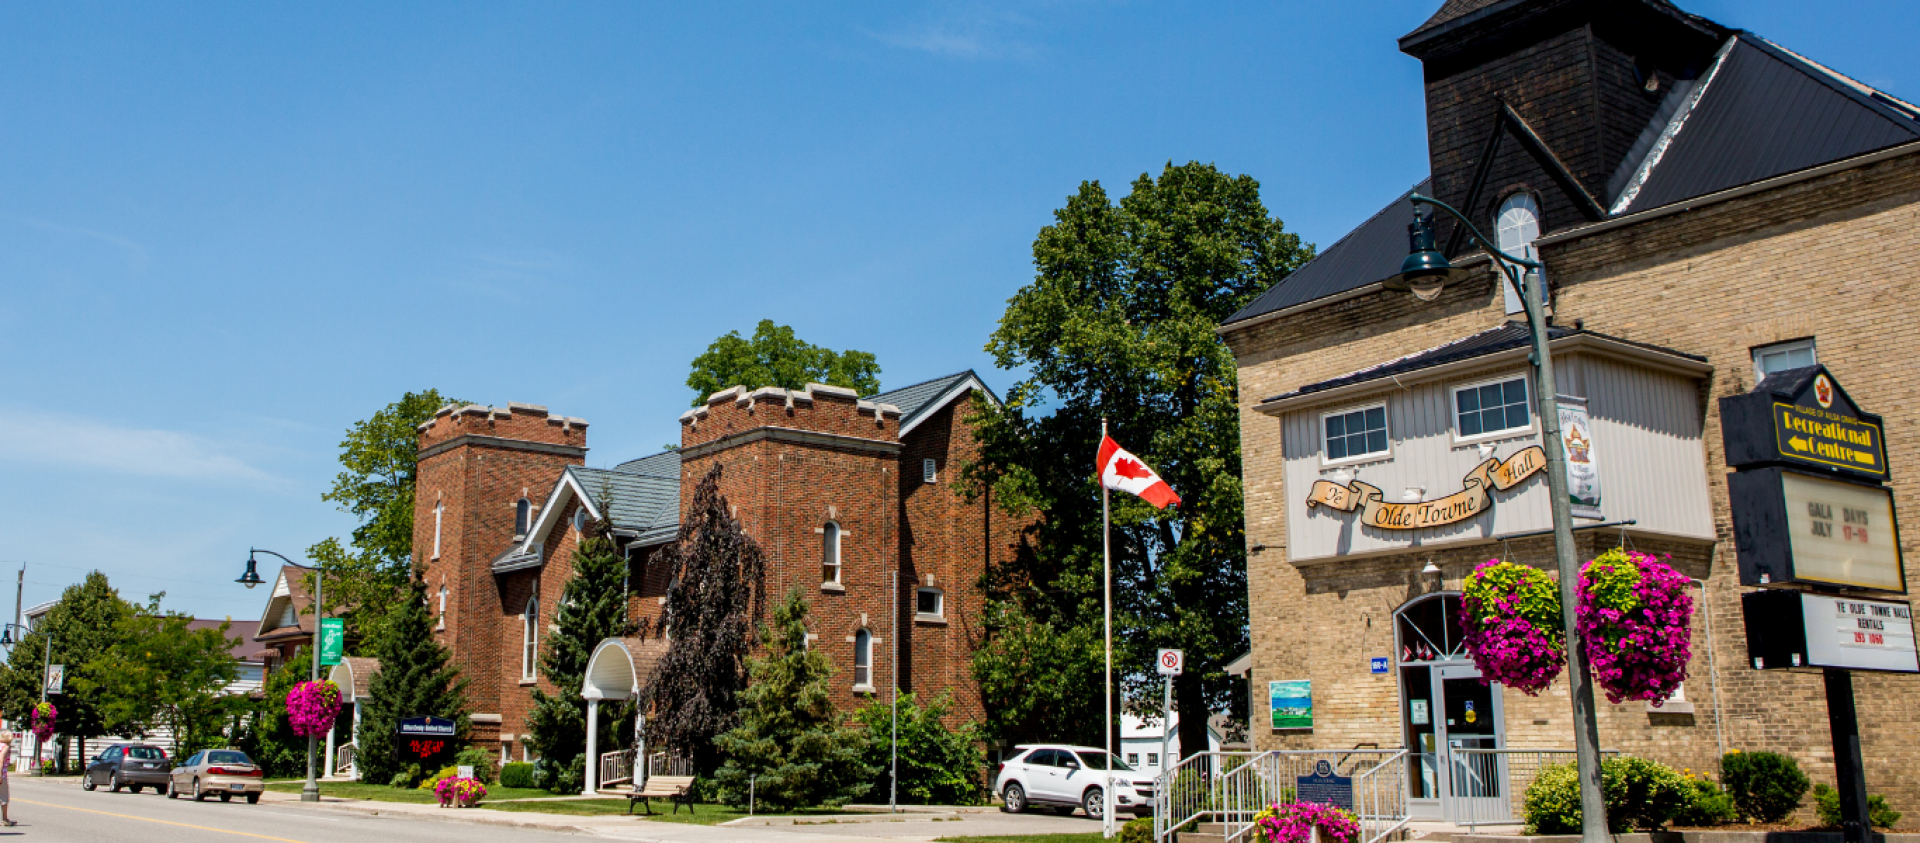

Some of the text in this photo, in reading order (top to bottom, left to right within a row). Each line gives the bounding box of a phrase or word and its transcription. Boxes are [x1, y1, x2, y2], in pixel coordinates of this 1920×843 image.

[1795, 404, 1858, 426] VILLAGE OF AILSA CRAIG
[1783, 411, 1872, 447] Recreational
[1808, 436, 1855, 462] Centre
[1325, 450, 1536, 527] Ye Olde Towne Hall
[1808, 502, 1869, 526] GALA DAYS
[1811, 520, 1869, 543] JULY 17-19
[1836, 602, 1910, 618] YE OLDE TOWNE HALL
[1857, 618, 1884, 630] RENTALS
[1854, 632, 1866, 643] 293
